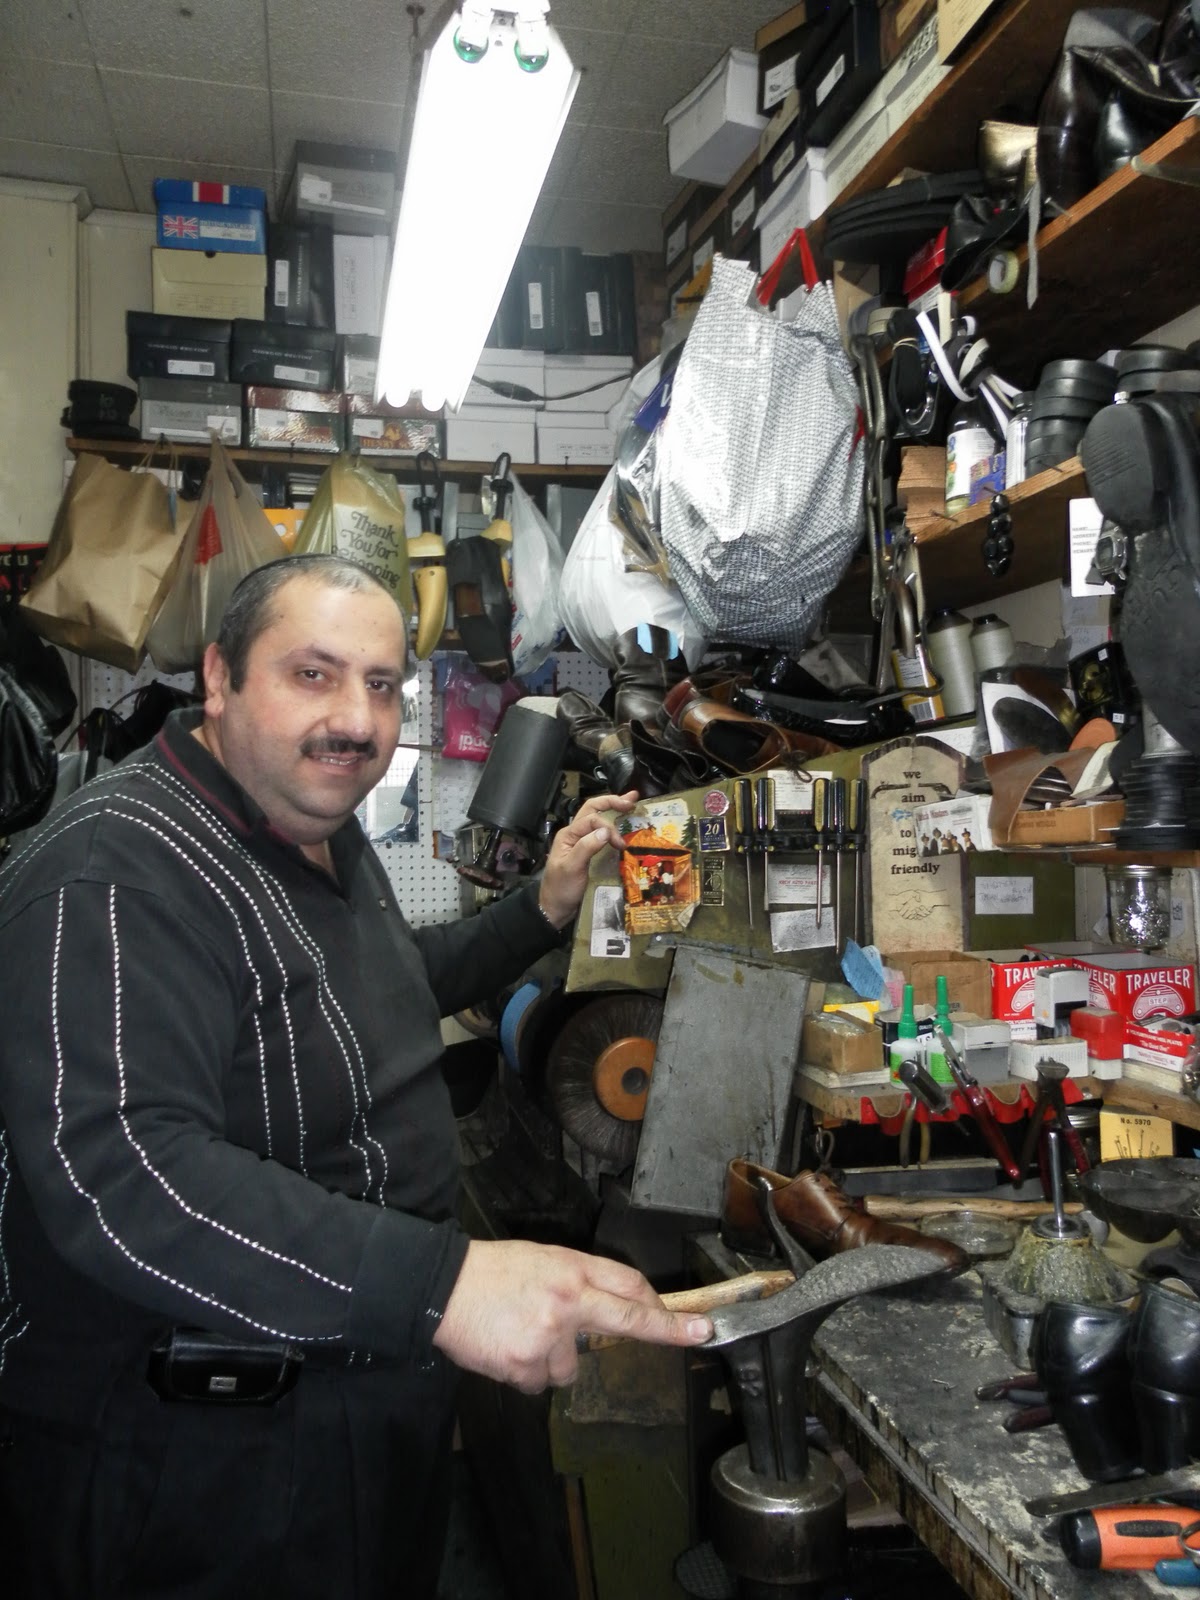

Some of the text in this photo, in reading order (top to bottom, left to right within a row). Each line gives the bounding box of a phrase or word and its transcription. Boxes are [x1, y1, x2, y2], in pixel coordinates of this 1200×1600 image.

[351, 511, 399, 548] Thank
[341, 529, 399, 560] You for
[903, 770, 922, 779] we
[901, 792, 926, 803] aim
[704, 823, 720, 836] 20
[900, 829, 912, 838] to
[892, 845, 918, 858] mig
[891, 862, 941, 875] friendly
[1126, 968, 1191, 995] TRAVELER
[1121, 1117, 1152, 1126] No. 5970
